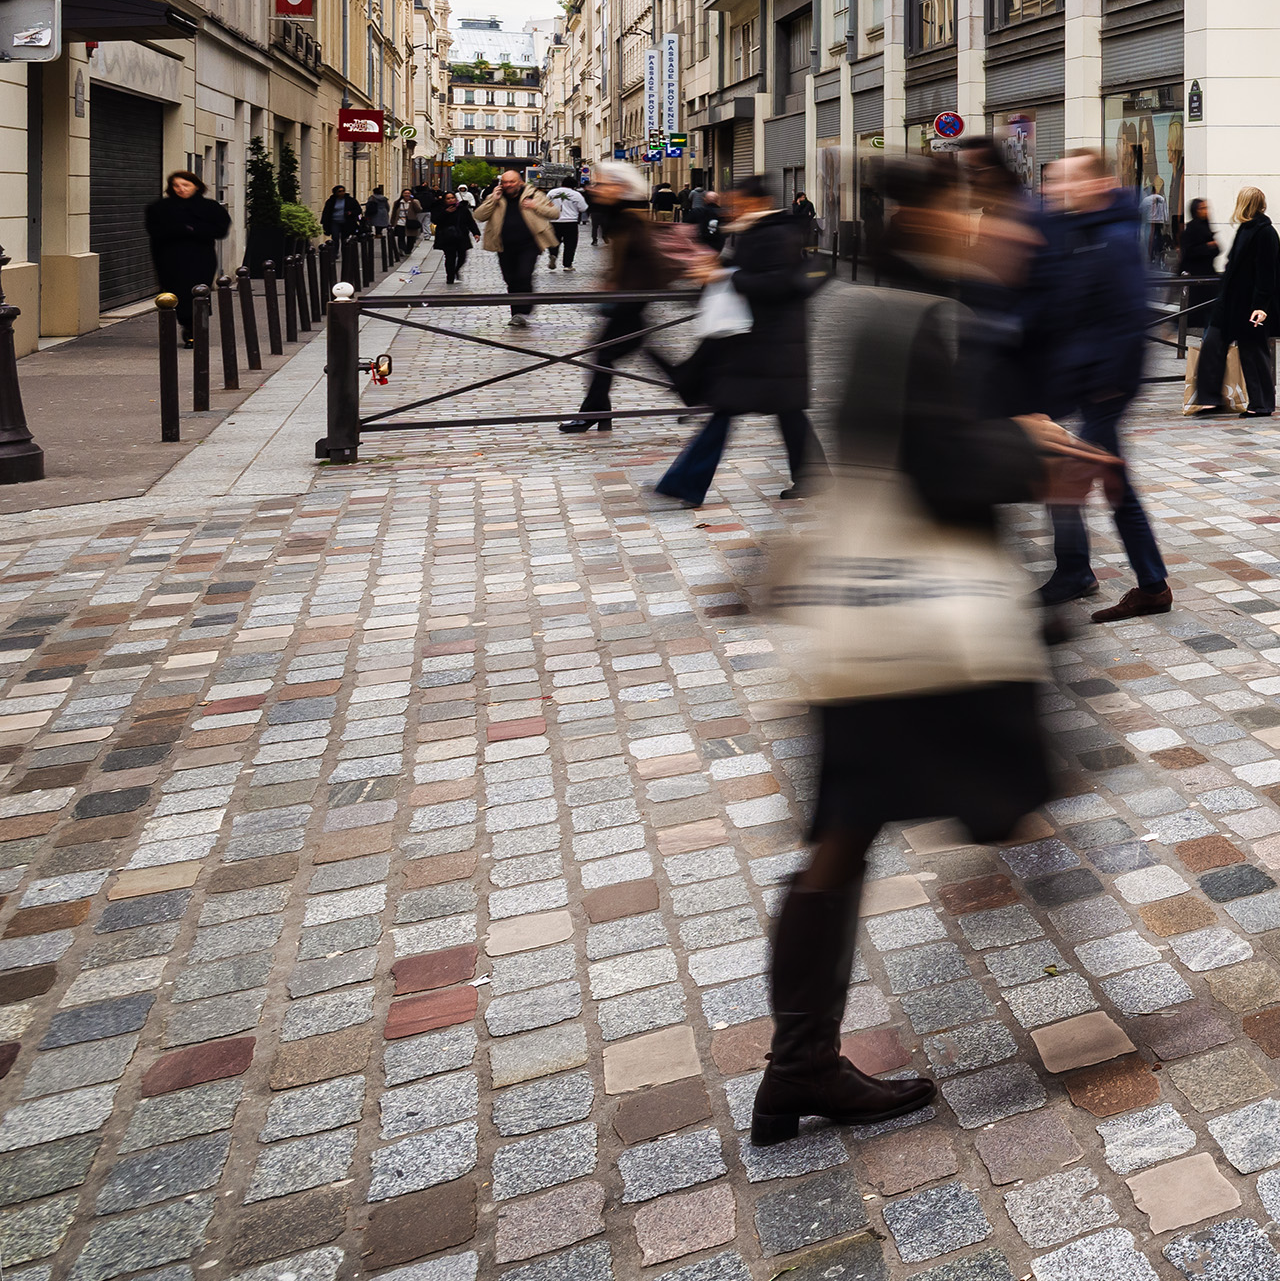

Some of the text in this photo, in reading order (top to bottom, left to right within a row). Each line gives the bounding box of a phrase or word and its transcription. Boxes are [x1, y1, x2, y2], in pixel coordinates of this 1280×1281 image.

[648, 54, 656, 91] PASSAGE
[667, 39, 676, 131] PASSAGE PROVENCE
